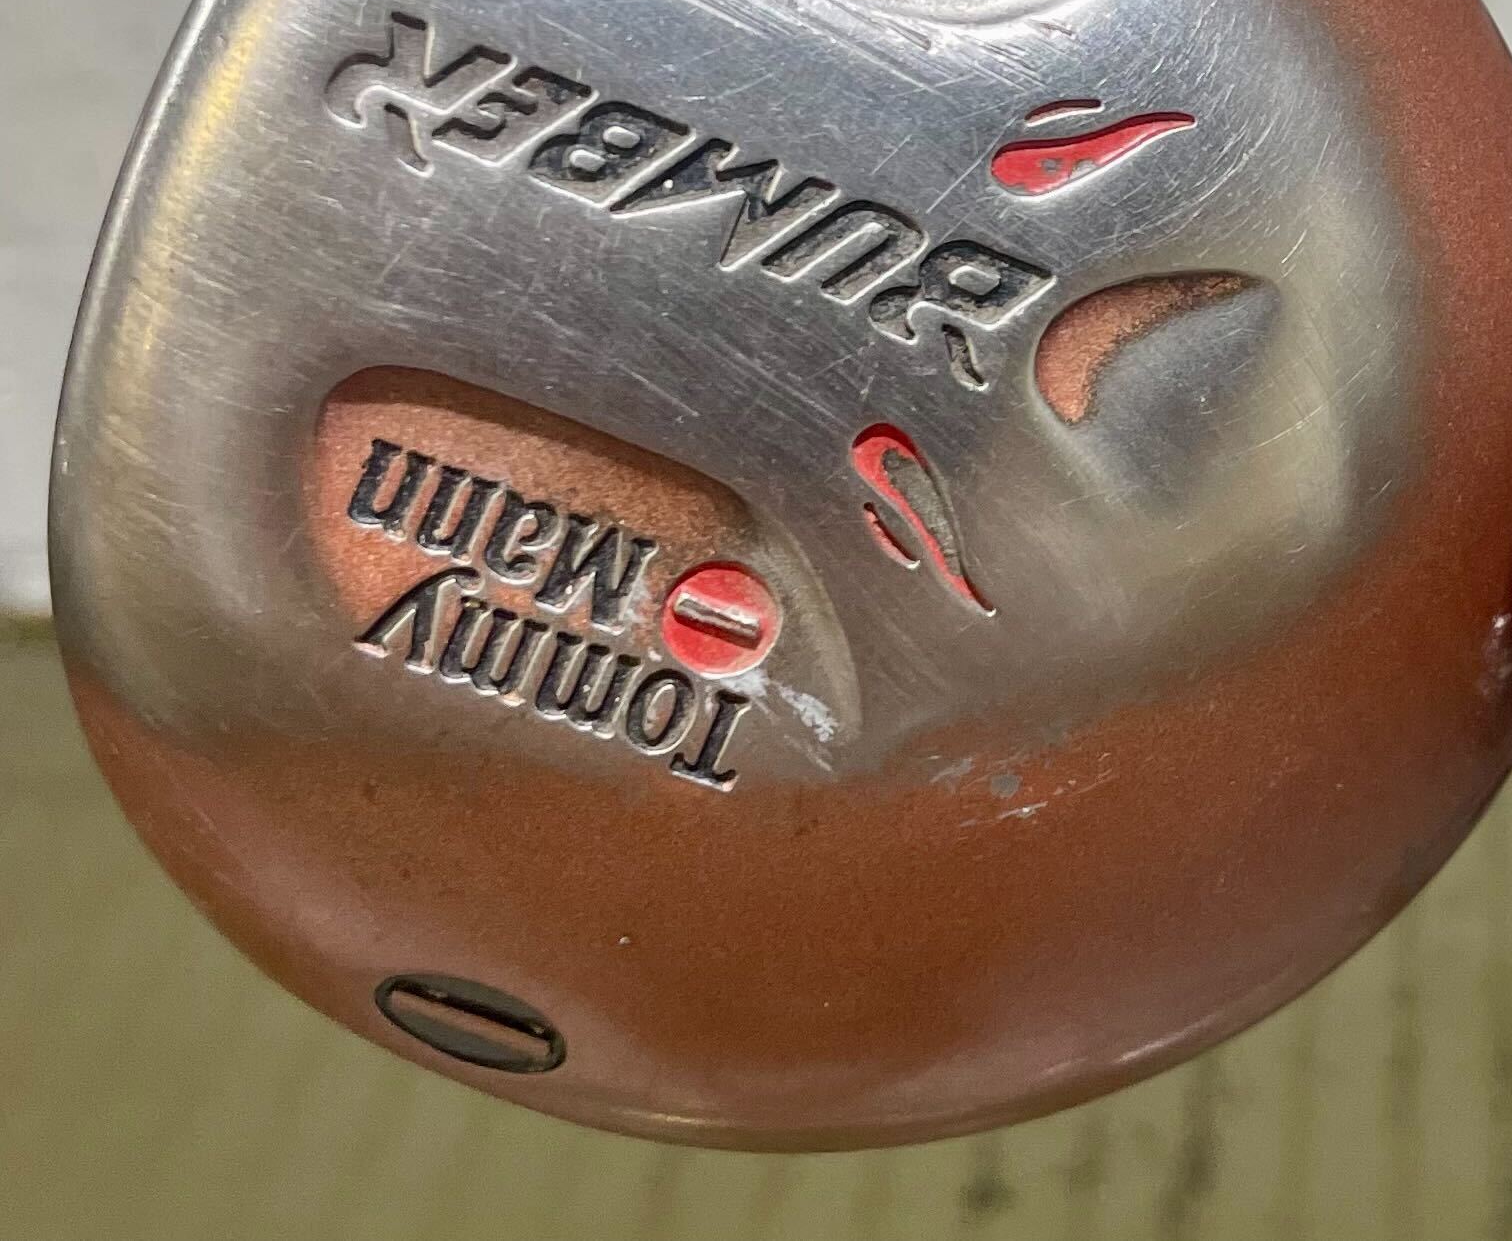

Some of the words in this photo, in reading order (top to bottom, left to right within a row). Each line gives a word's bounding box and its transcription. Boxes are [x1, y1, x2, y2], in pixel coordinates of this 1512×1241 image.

[323, 10, 1058, 392] BUMBER
[346, 438, 660, 635] Mann
[351, 566, 752, 793] Tommy
